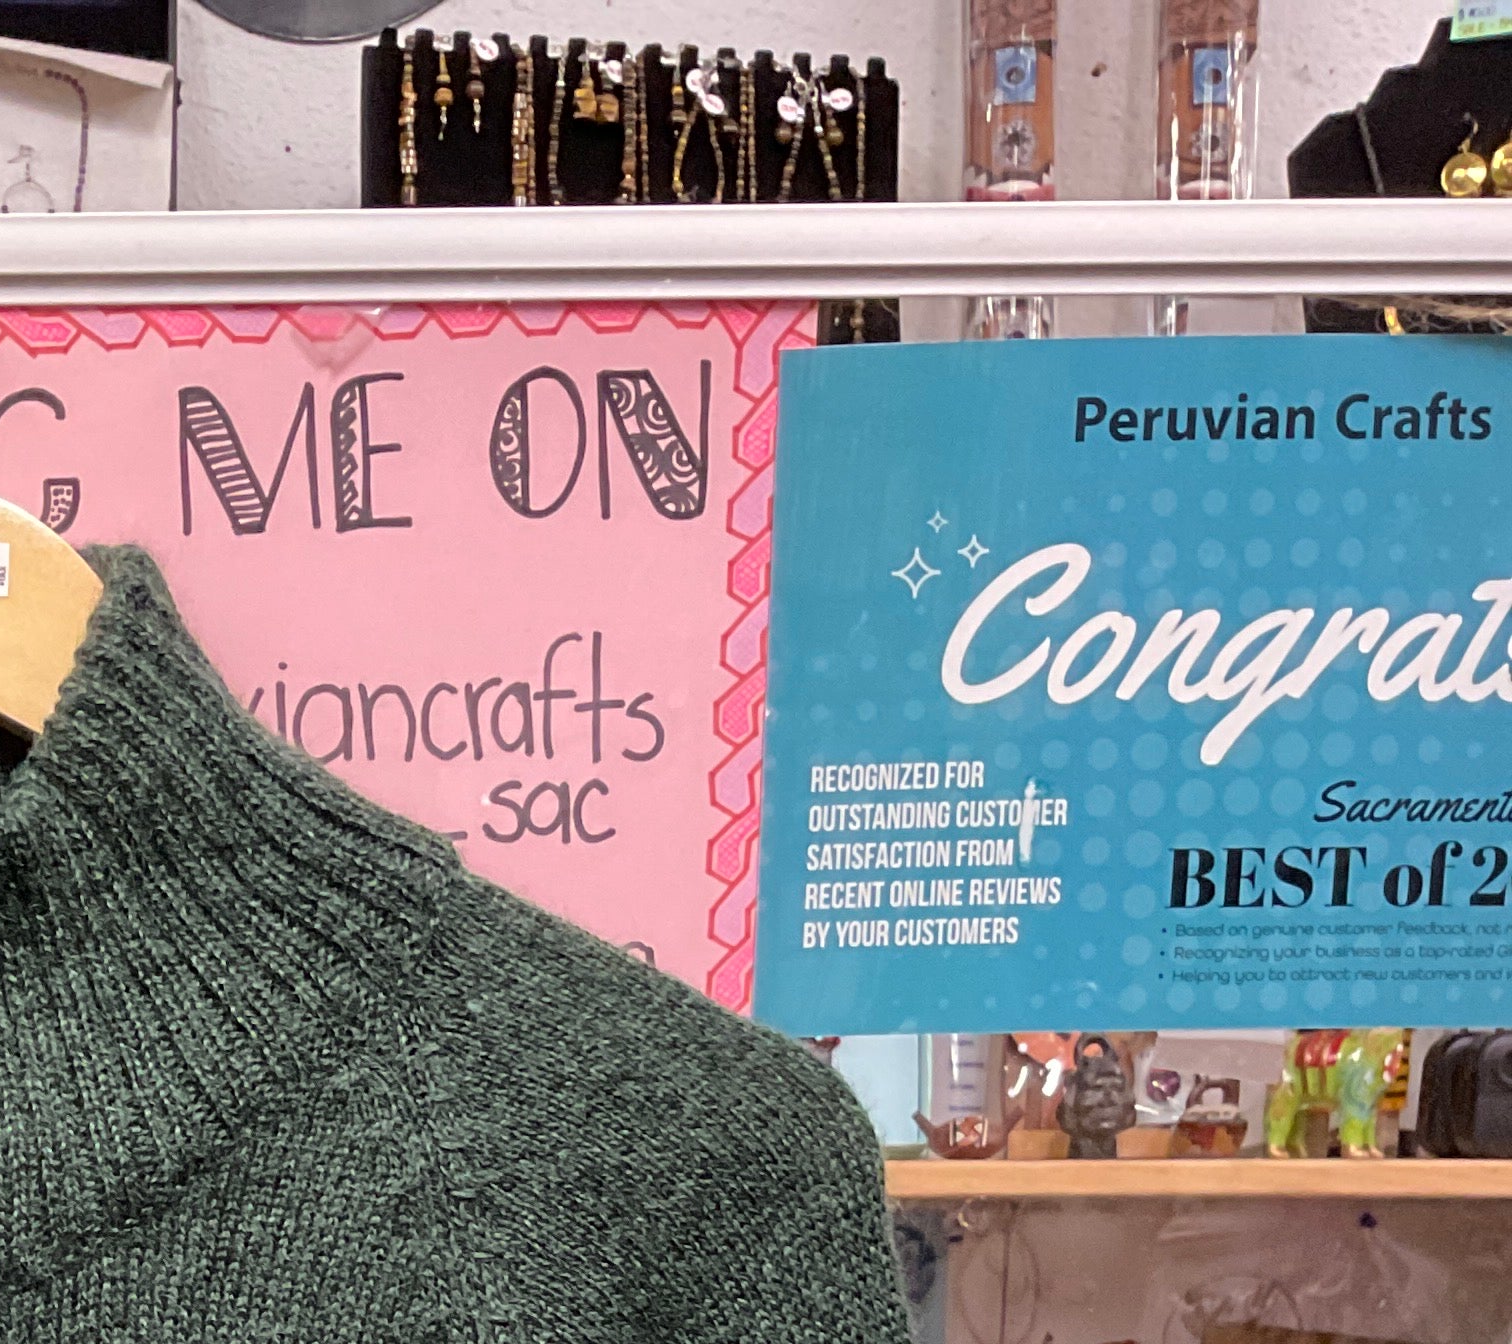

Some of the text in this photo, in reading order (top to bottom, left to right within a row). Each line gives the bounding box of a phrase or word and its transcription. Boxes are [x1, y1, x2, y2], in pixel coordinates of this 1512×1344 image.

[1075, 391, 1492, 442] Peruvian Crafts
[177, 372, 412, 535] ME
[489, 359, 712, 520] ON
[941, 542, 1512, 766] Congrat
[810, 761, 984, 792] RECOGNIZED FOR
[808, 801, 951, 832] OUTSTANDING
[806, 839, 1014, 871] SATISFACTION FROM
[1165, 840, 1512, 908] BEST of 2
[804, 877, 1061, 909] RECENT ONLINE REVIEWS
[802, 917, 1019, 948] BY YOUR CUSTOMERS
[1175, 924, 1224, 937] Based
[1317, 923, 1392, 936] customer
[1172, 969, 1230, 985] Helping
